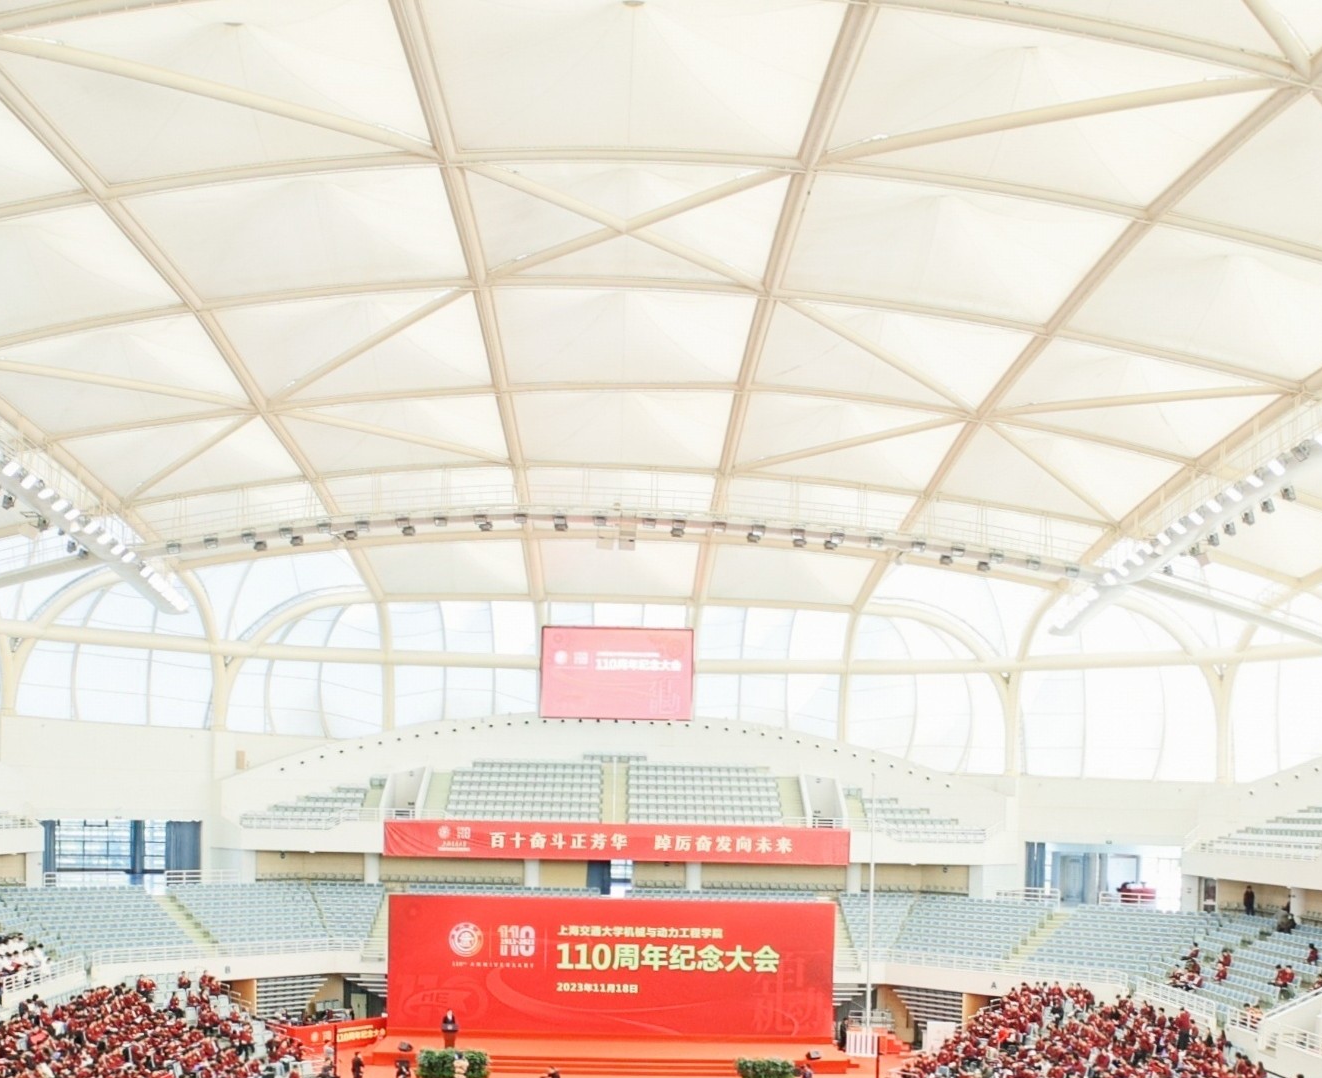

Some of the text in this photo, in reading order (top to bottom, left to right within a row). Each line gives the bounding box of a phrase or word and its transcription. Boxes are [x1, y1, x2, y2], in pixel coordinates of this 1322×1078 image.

[489, 831, 628, 851] 百十奋斗正芳华
[654, 834, 793, 854] 踔厉奋发向未来
[557, 925, 724, 939] 上海交通大学机械与动力工程学院
[556, 942, 780, 973] 110周年纪念大会
[556, 982, 639, 994] 2023年11月18日
